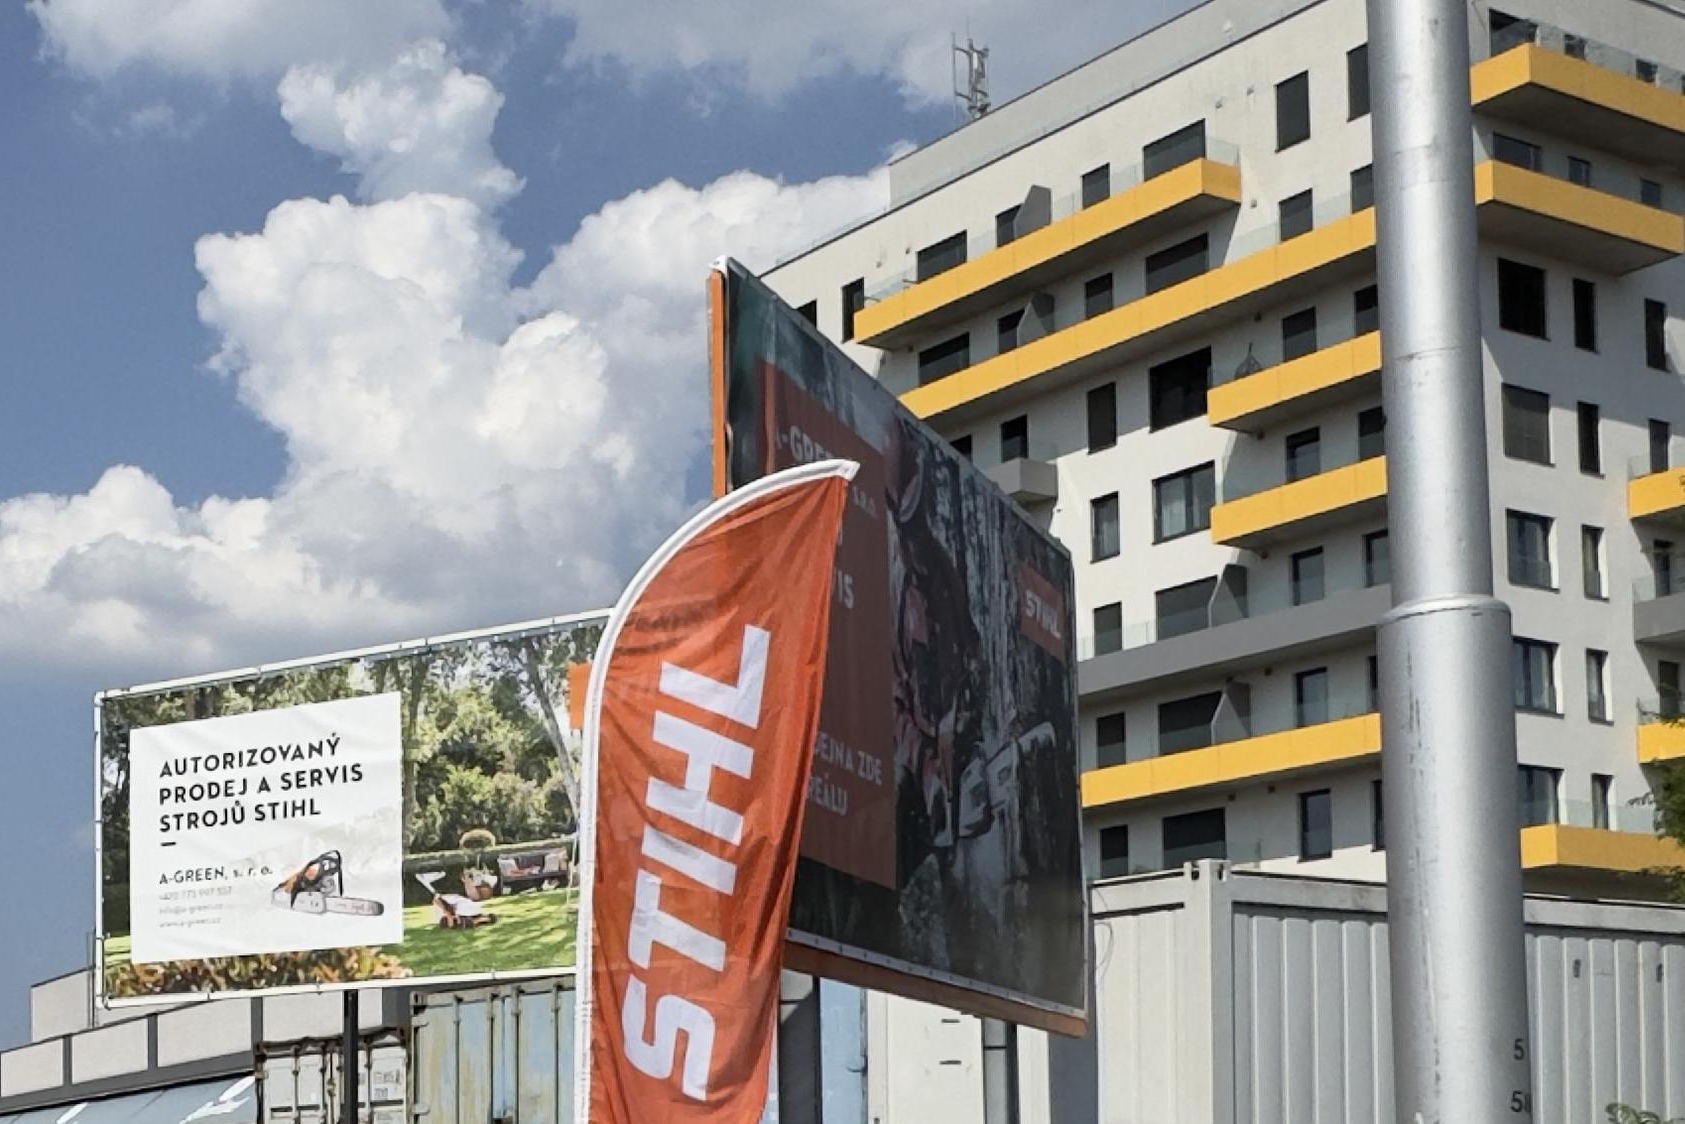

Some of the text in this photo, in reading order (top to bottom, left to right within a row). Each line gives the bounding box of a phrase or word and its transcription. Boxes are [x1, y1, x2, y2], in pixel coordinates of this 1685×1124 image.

[159, 732, 341, 779] AUTORIZOVANÝ
[159, 763, 364, 806] PRODEJ A SERVIS
[159, 798, 322, 833] STROJŮ STIHL
[159, 866, 229, 885] A-GREEN,
[622, 624, 771, 1101] STIHL
[1513, 1038, 1525, 1061] 5
